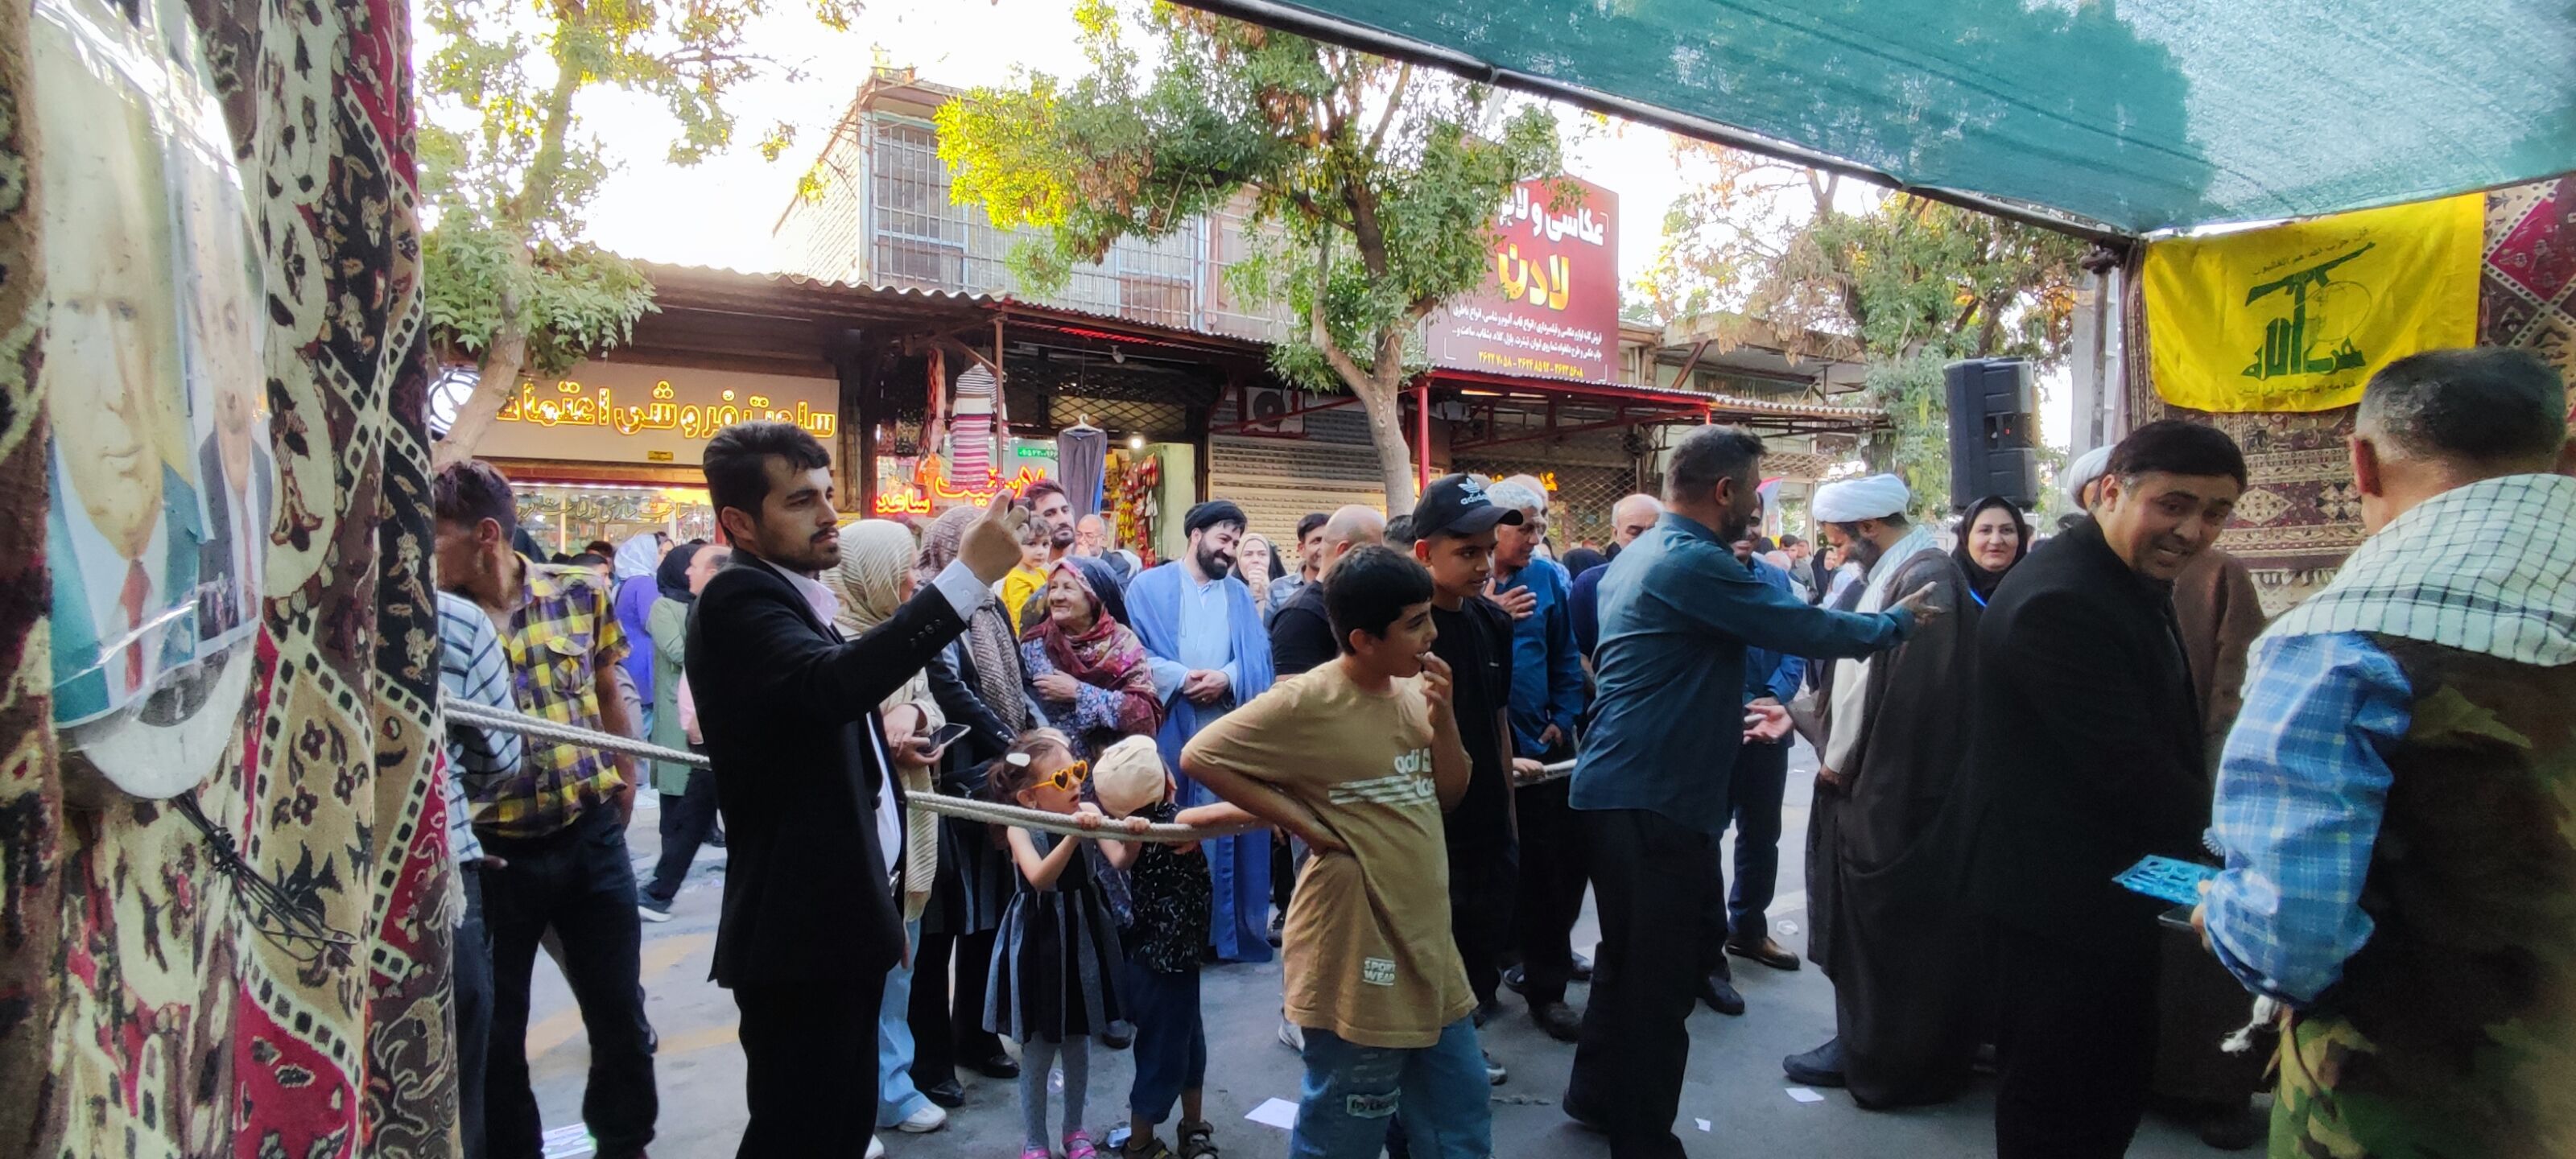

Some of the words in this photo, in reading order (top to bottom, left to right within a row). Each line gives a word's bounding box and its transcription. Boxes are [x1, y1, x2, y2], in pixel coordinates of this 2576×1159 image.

[1531, 201, 1543, 237] و
[1546, 207, 1604, 246] عکاسی
[1497, 243, 1569, 311] لادن
[496, 380, 609, 427] اعتماد
[613, 380, 739, 439] فروشی
[1364, 959, 1397, 973] SPORT
[1364, 970, 1396, 983] WEAR
